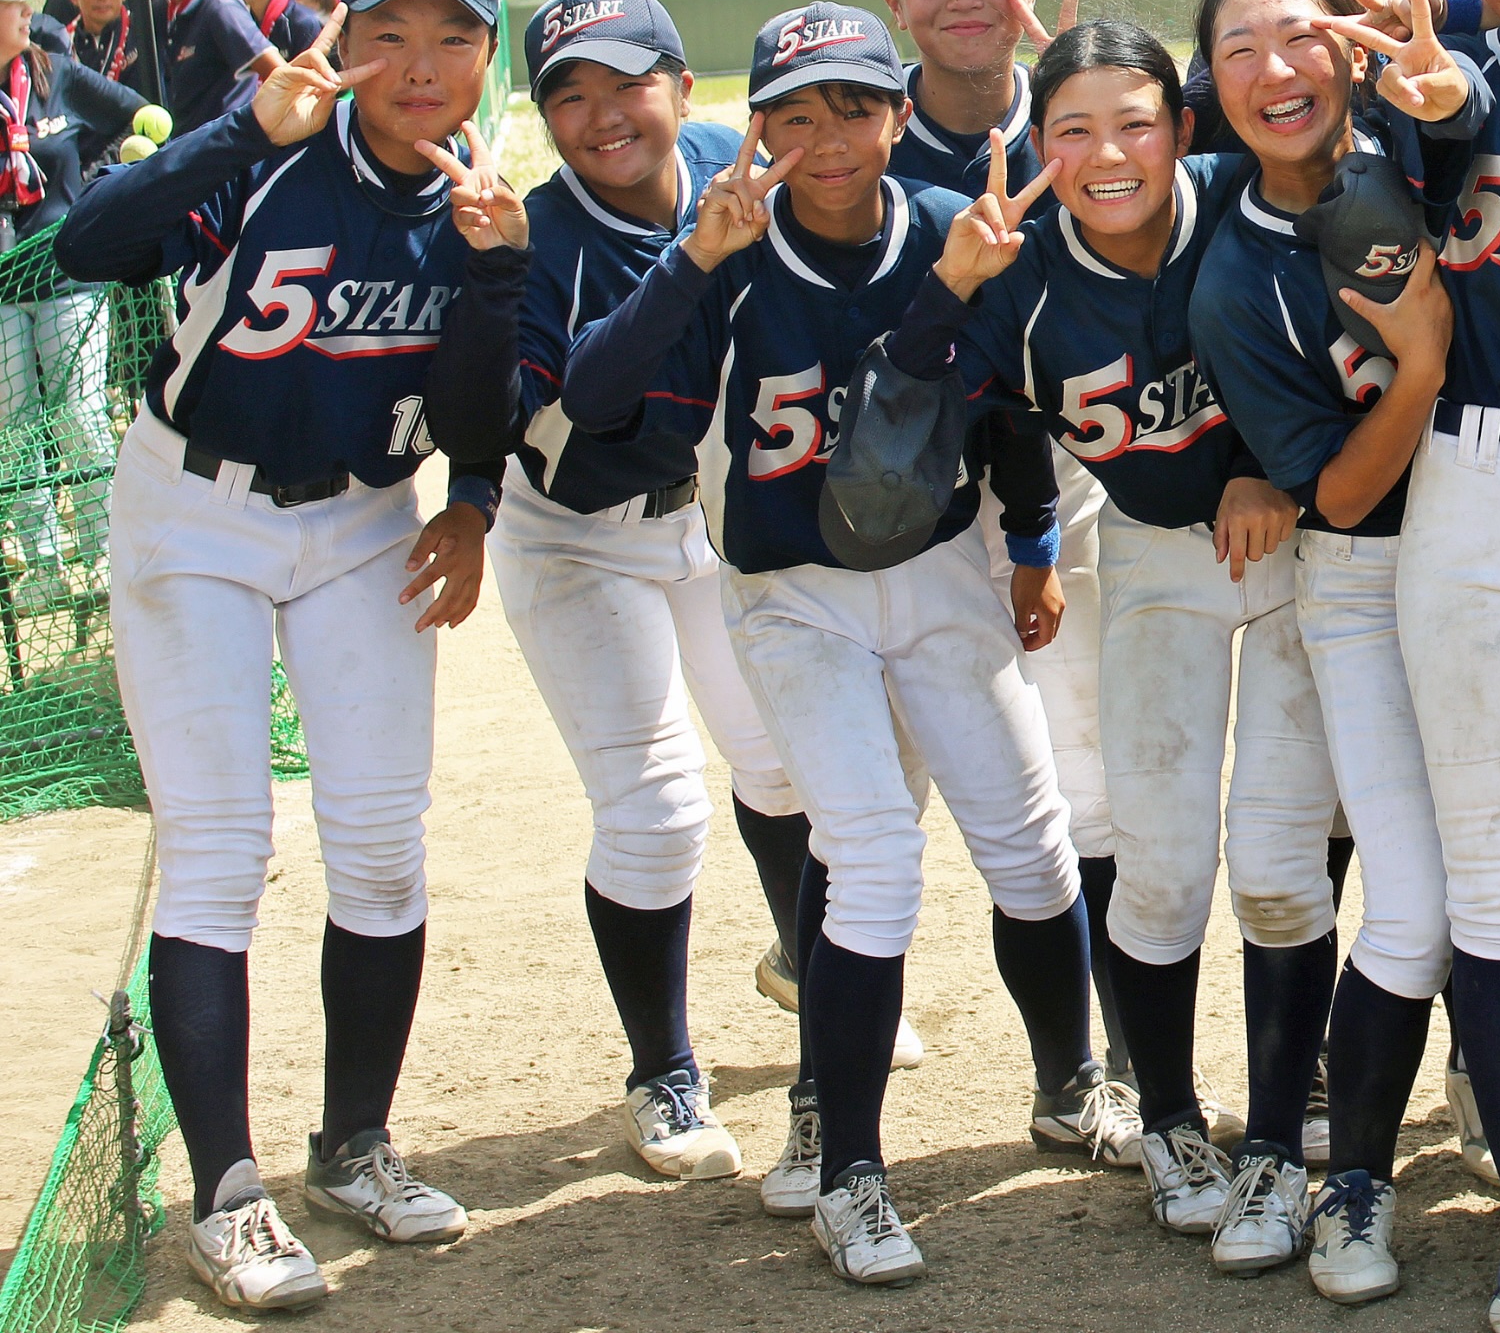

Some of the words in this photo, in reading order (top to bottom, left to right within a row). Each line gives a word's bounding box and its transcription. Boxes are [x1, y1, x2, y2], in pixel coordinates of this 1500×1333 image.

[541, 3, 625, 52] 5START
[772, 16, 865, 66] 5START
[217, 244, 462, 360] 5STAR
[858, 1173, 883, 1186] asics
